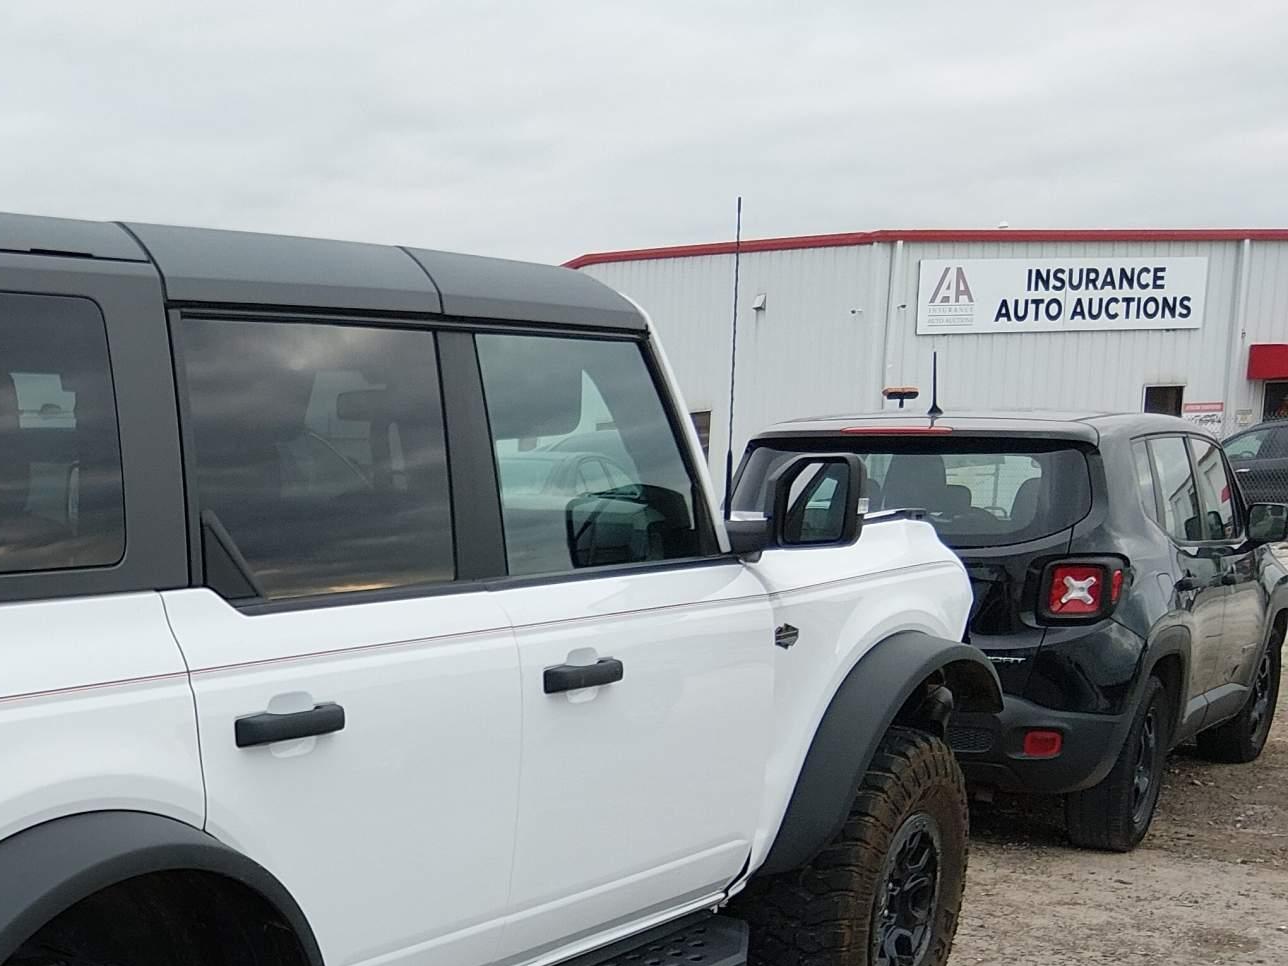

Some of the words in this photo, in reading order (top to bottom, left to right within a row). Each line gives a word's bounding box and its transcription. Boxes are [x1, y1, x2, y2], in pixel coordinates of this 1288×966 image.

[1028, 267, 1166, 291] INSURANCE
[995, 298, 1062, 322] AUTO
[1070, 296, 1191, 320] AUCTIONS
